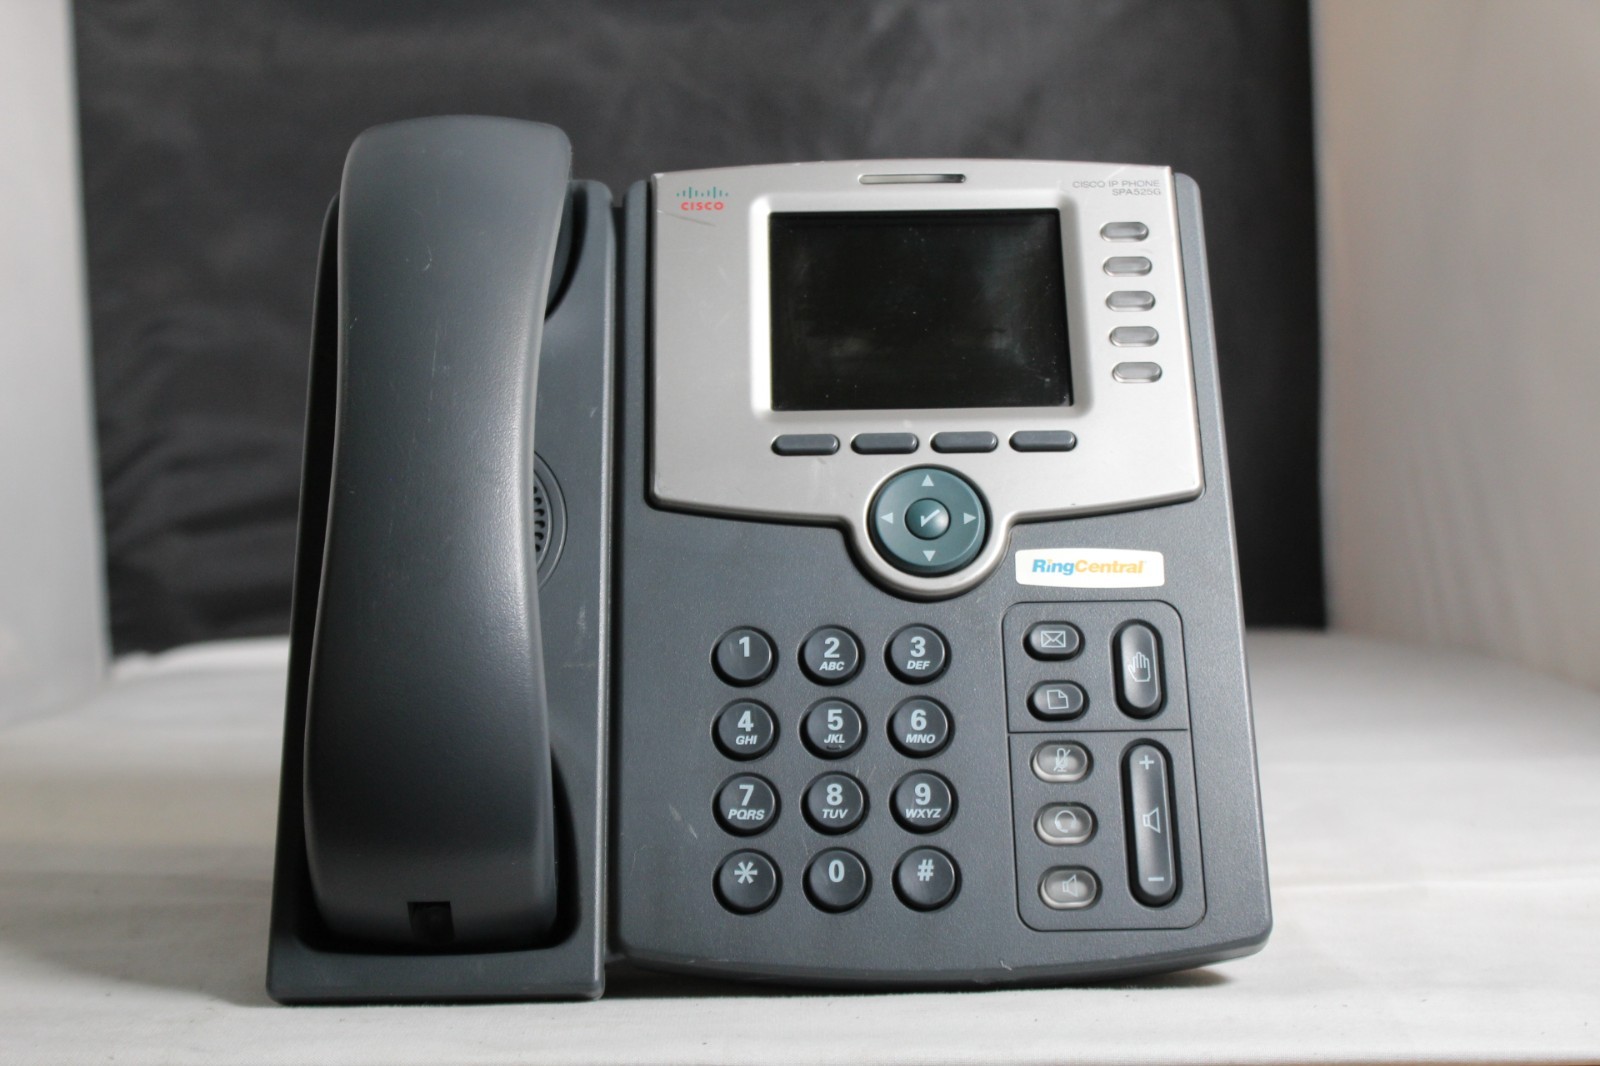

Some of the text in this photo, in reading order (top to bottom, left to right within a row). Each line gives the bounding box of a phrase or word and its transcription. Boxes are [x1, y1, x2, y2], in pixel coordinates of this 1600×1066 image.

[1072, 179, 1160, 189] CISCO IP PHONE
[1111, 188, 1161, 197] SPA525G
[680, 201, 724, 211] CISCO
[1031, 558, 1144, 576] RingCentral
[738, 636, 750, 657] 1
[823, 637, 840, 658] 2
[910, 636, 926, 657] 3
[819, 661, 845, 671] ABC
[906, 660, 930, 670] DEF
[737, 710, 754, 731] 4
[827, 709, 843, 731] 5
[910, 709, 927, 731] 6
[735, 735, 757, 745] GHI
[823, 733, 845, 743] JKL
[905, 733, 936, 744] MNO
[738, 784, 754, 806] 7
[826, 783, 843, 806] 8
[914, 783, 931, 806] 9
[727, 809, 765, 820] PQRS
[822, 809, 848, 819] TUV
[905, 808, 941, 818] WXYZ
[828, 859, 845, 882] 0
